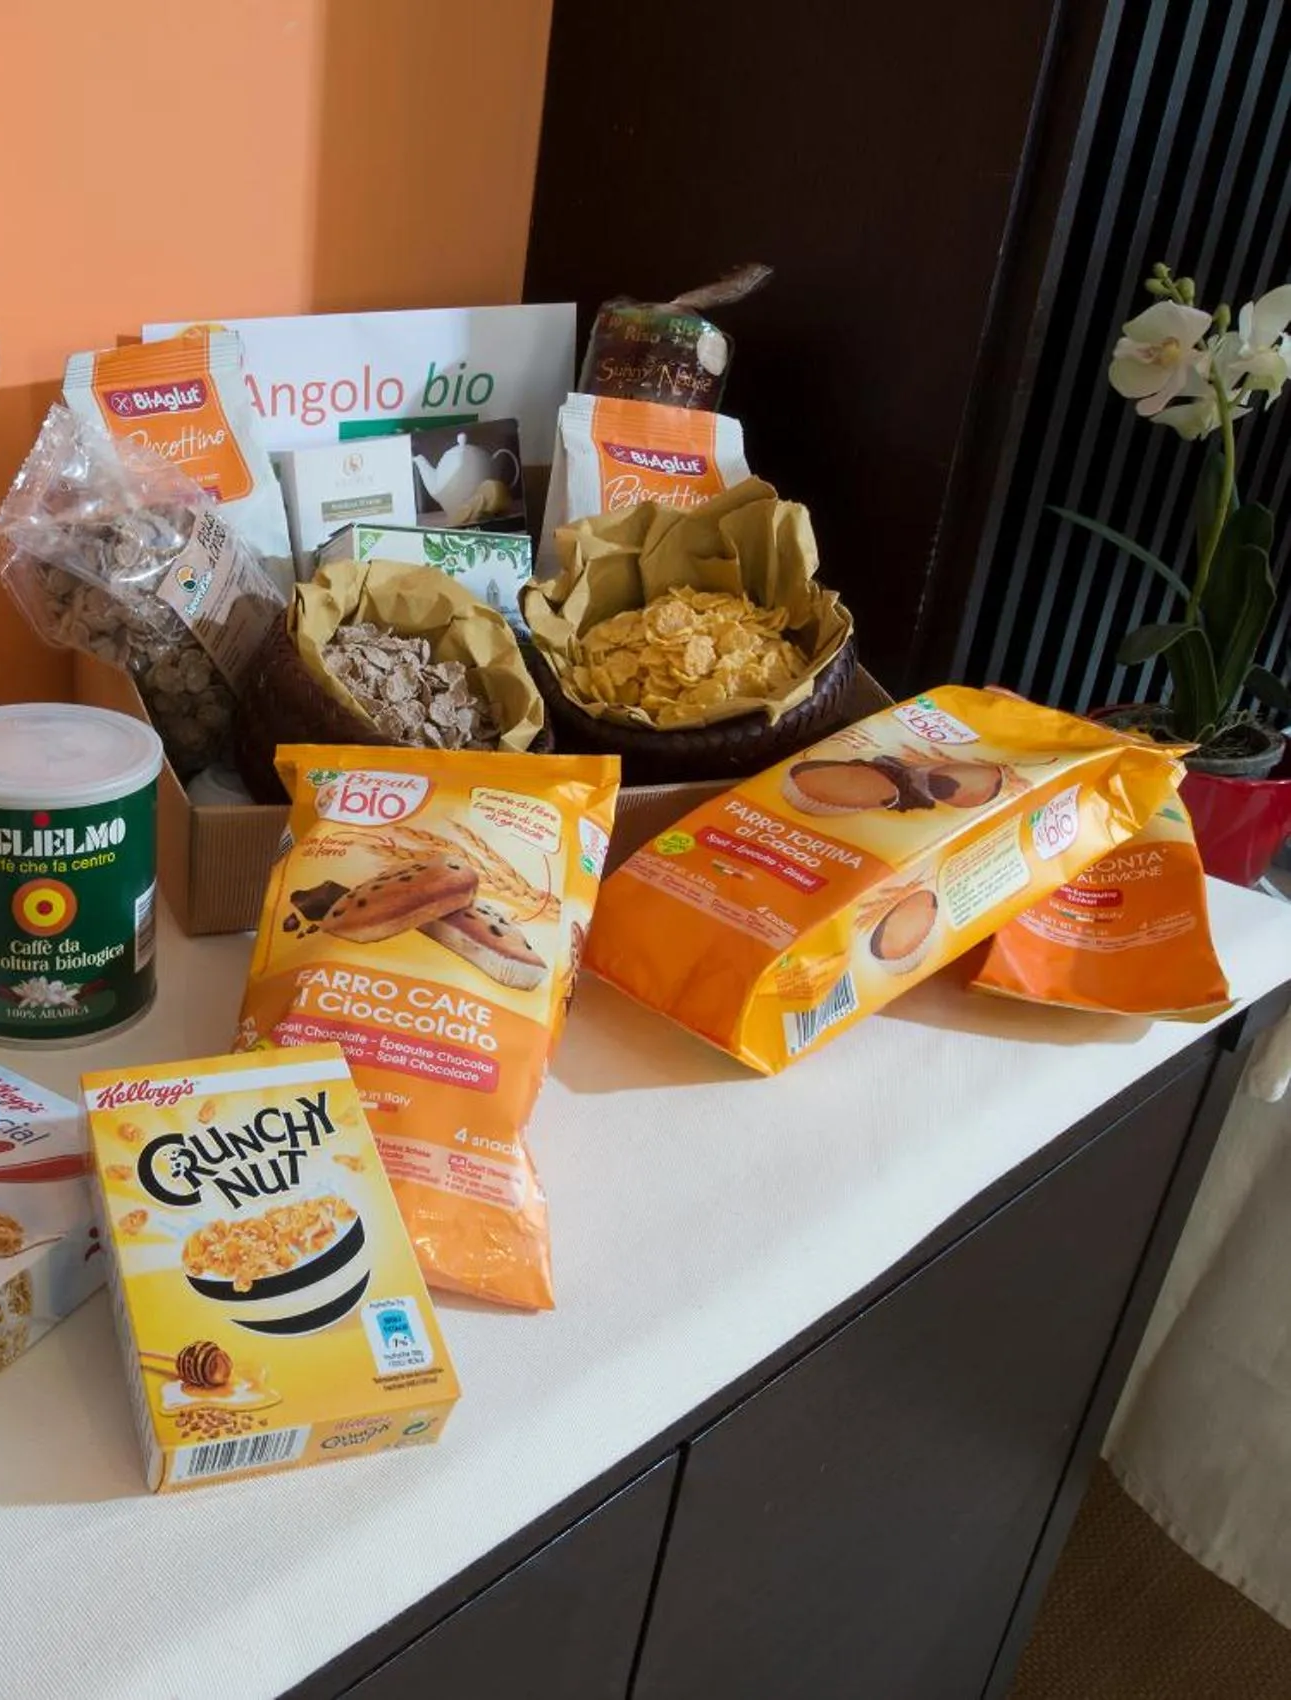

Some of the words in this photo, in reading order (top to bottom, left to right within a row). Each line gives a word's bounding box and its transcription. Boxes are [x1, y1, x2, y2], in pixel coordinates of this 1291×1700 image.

[421, 361, 494, 408] bio
[339, 785, 407, 819] bio
[725, 800, 785, 834] FARRO
[786, 829, 863, 869] TORTINA
[18, 860, 49, 874] che
[71, 852, 116, 871] centro
[10, 939, 53, 955] Caffè
[58, 938, 80, 953] da
[55, 943, 125, 971] biologica
[295, 967, 398, 1001] FARRO
[407, 987, 493, 1028] CAKE
[306, 1026, 368, 1044] Chocolate
[317, 991, 498, 1052] Cioccolato
[96, 1078, 196, 1110] Kellogg's
[137, 1091, 336, 1207] CRUNCHY
[454, 1127, 469, 1145] 4
[213, 1149, 308, 1210] NUT
